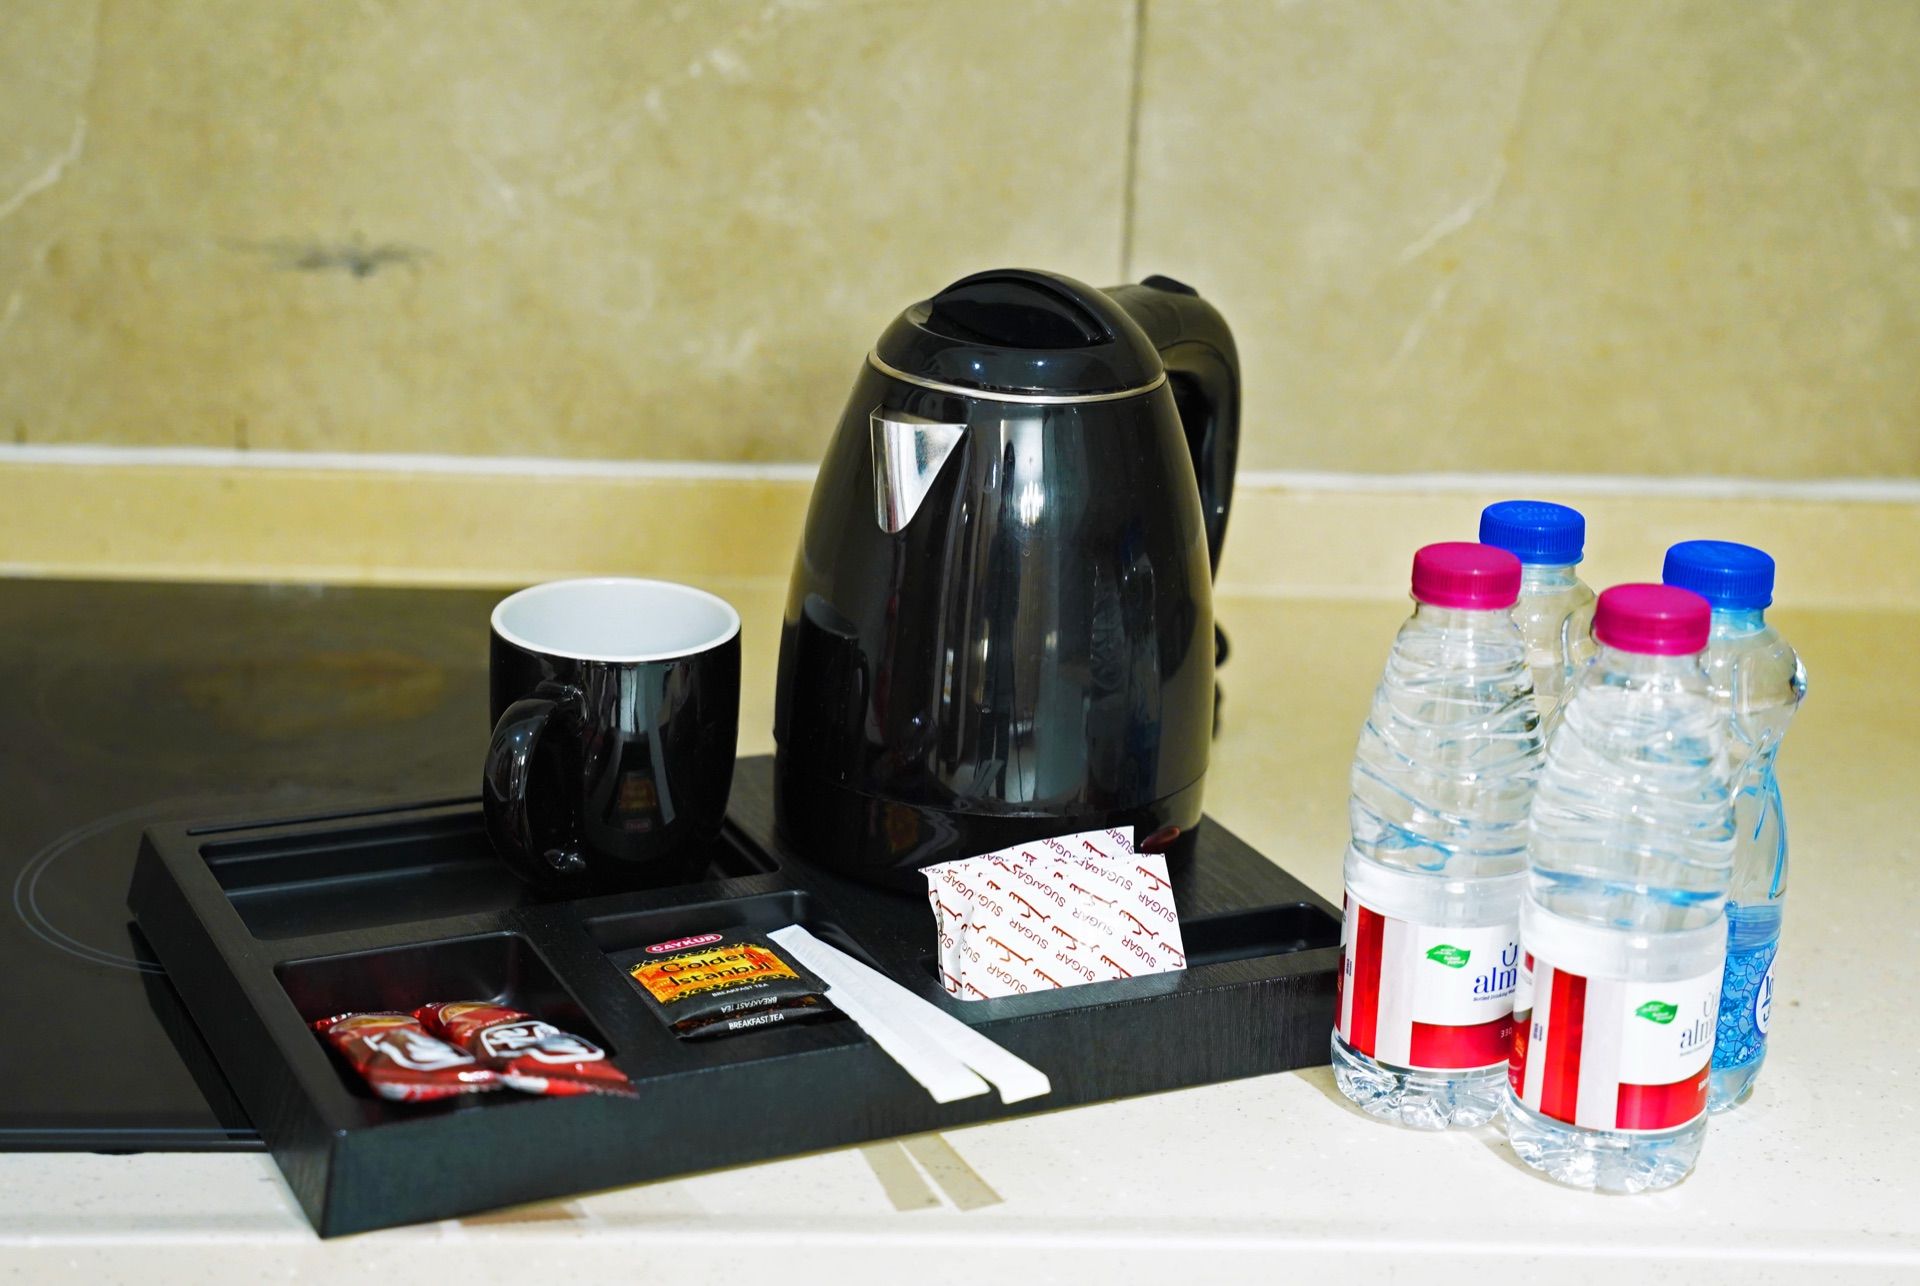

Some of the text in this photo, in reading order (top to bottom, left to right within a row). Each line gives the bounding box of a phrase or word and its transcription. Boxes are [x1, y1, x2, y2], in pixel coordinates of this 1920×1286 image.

[1072, 907, 1113, 936] SUGAR
[1138, 891, 1177, 923] SUGAR
[1009, 918, 1049, 950] SUGAR
[660, 951, 757, 973] Golden
[1055, 950, 1096, 982] SUGAR
[1121, 935, 1157, 968] SUGAR
[668, 961, 774, 987] Istanbul
[986, 962, 1028, 994] SUGAR
[1473, 967, 1517, 994] alm
[728, 1013, 784, 1030] BREAKFAST TEA
